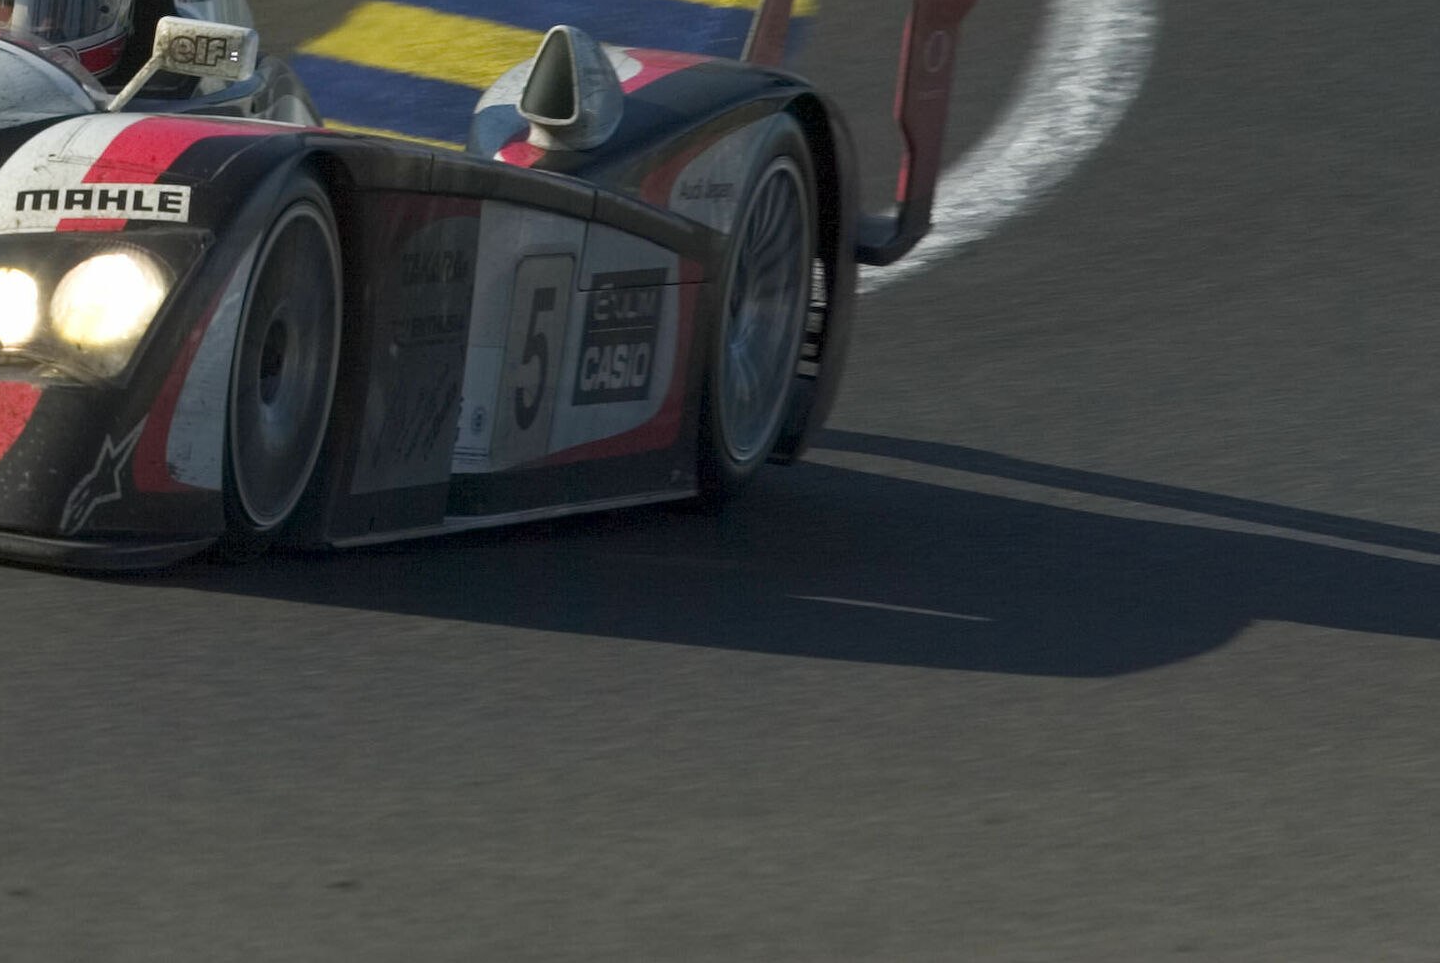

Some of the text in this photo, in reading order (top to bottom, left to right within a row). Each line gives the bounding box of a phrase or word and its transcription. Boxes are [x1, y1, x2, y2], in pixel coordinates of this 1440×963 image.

[169, 35, 228, 67] elf
[15, 189, 183, 214] MAHLE
[514, 287, 557, 430] 5
[579, 342, 651, 392] CASIO
